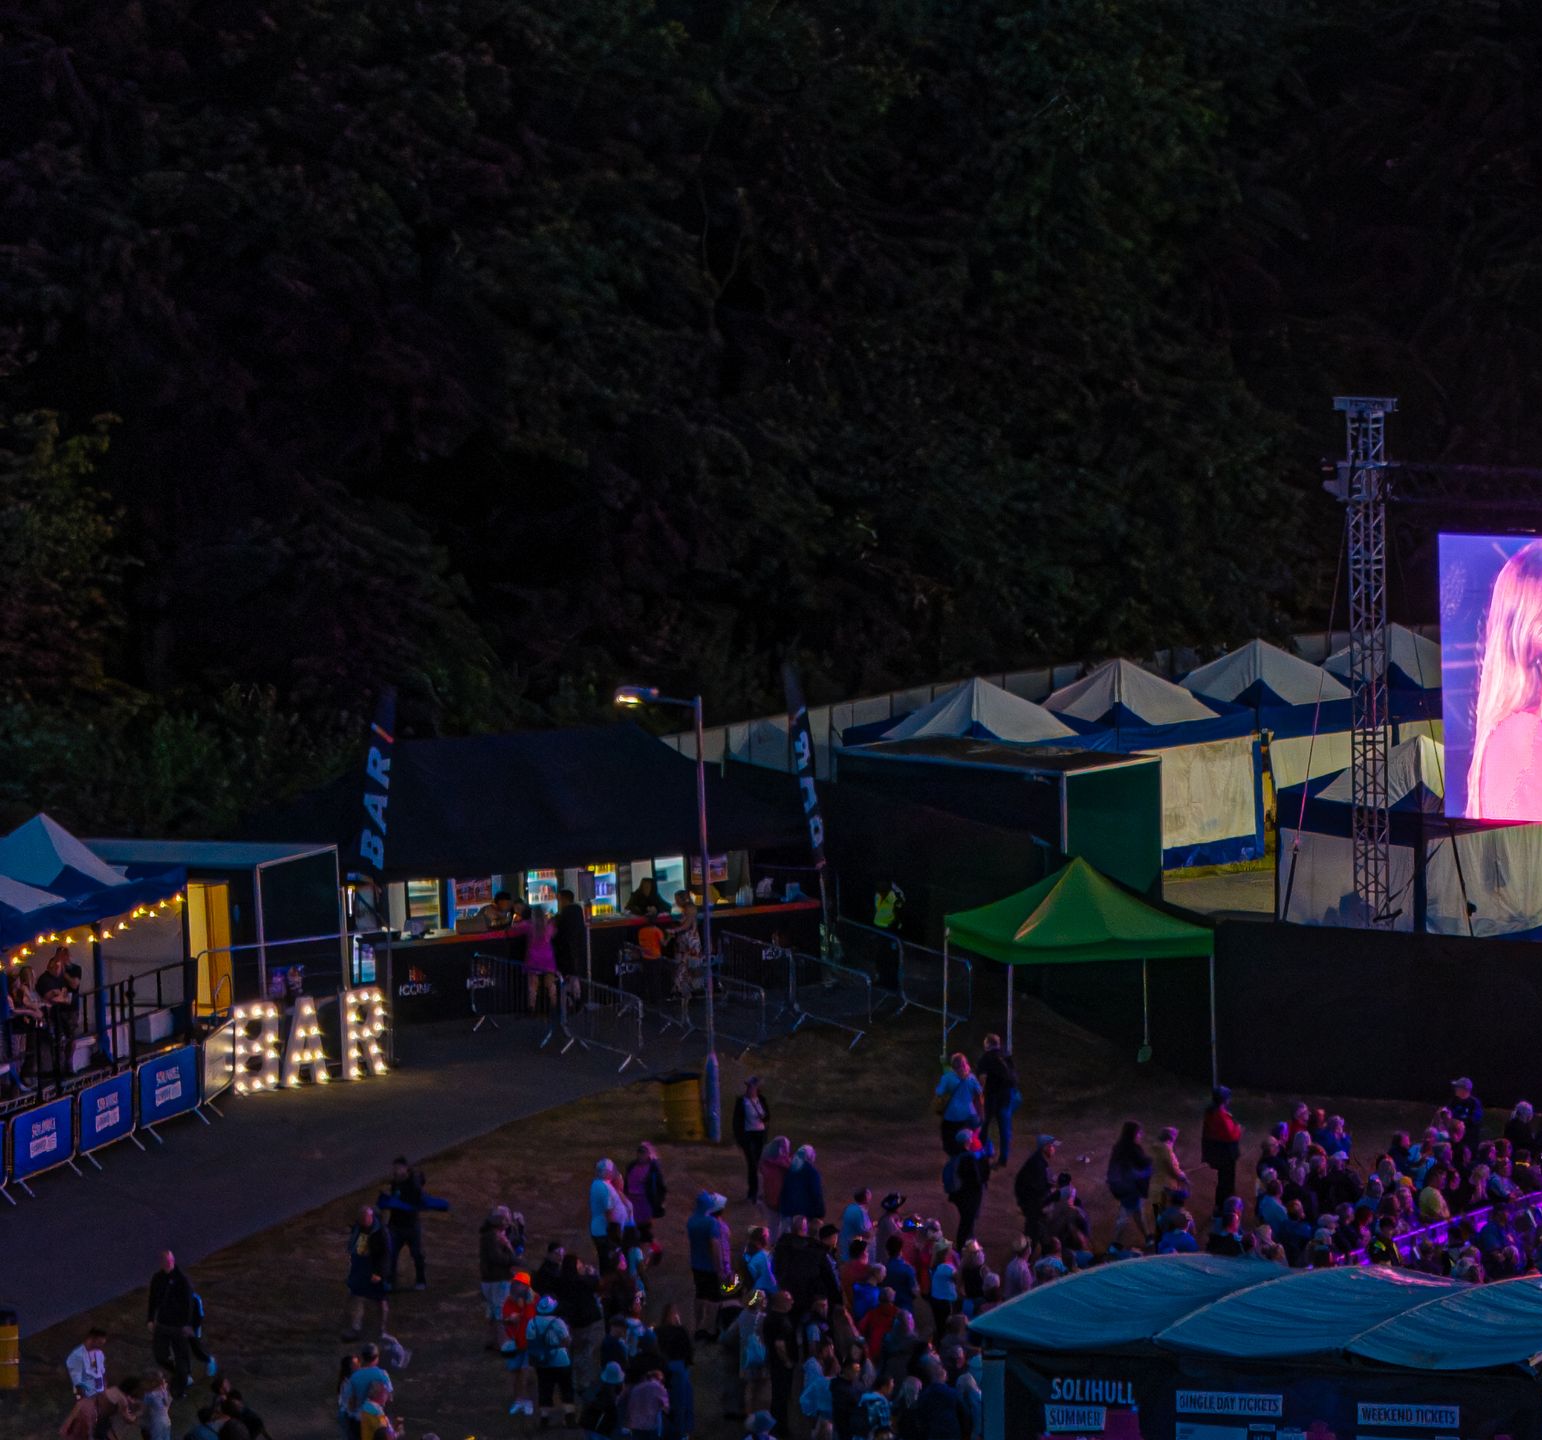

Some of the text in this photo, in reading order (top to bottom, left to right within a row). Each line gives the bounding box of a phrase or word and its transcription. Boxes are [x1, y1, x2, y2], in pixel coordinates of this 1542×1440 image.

[360, 746, 391, 871] BAR
[233, 988, 390, 1095] BAR
[1050, 1377, 1136, 1404] SOLIHULL
[1179, 1395, 1279, 1412] SINGLE DAY TICKETS
[1361, 1407, 1456, 1425] WEEKEND TICKETS
